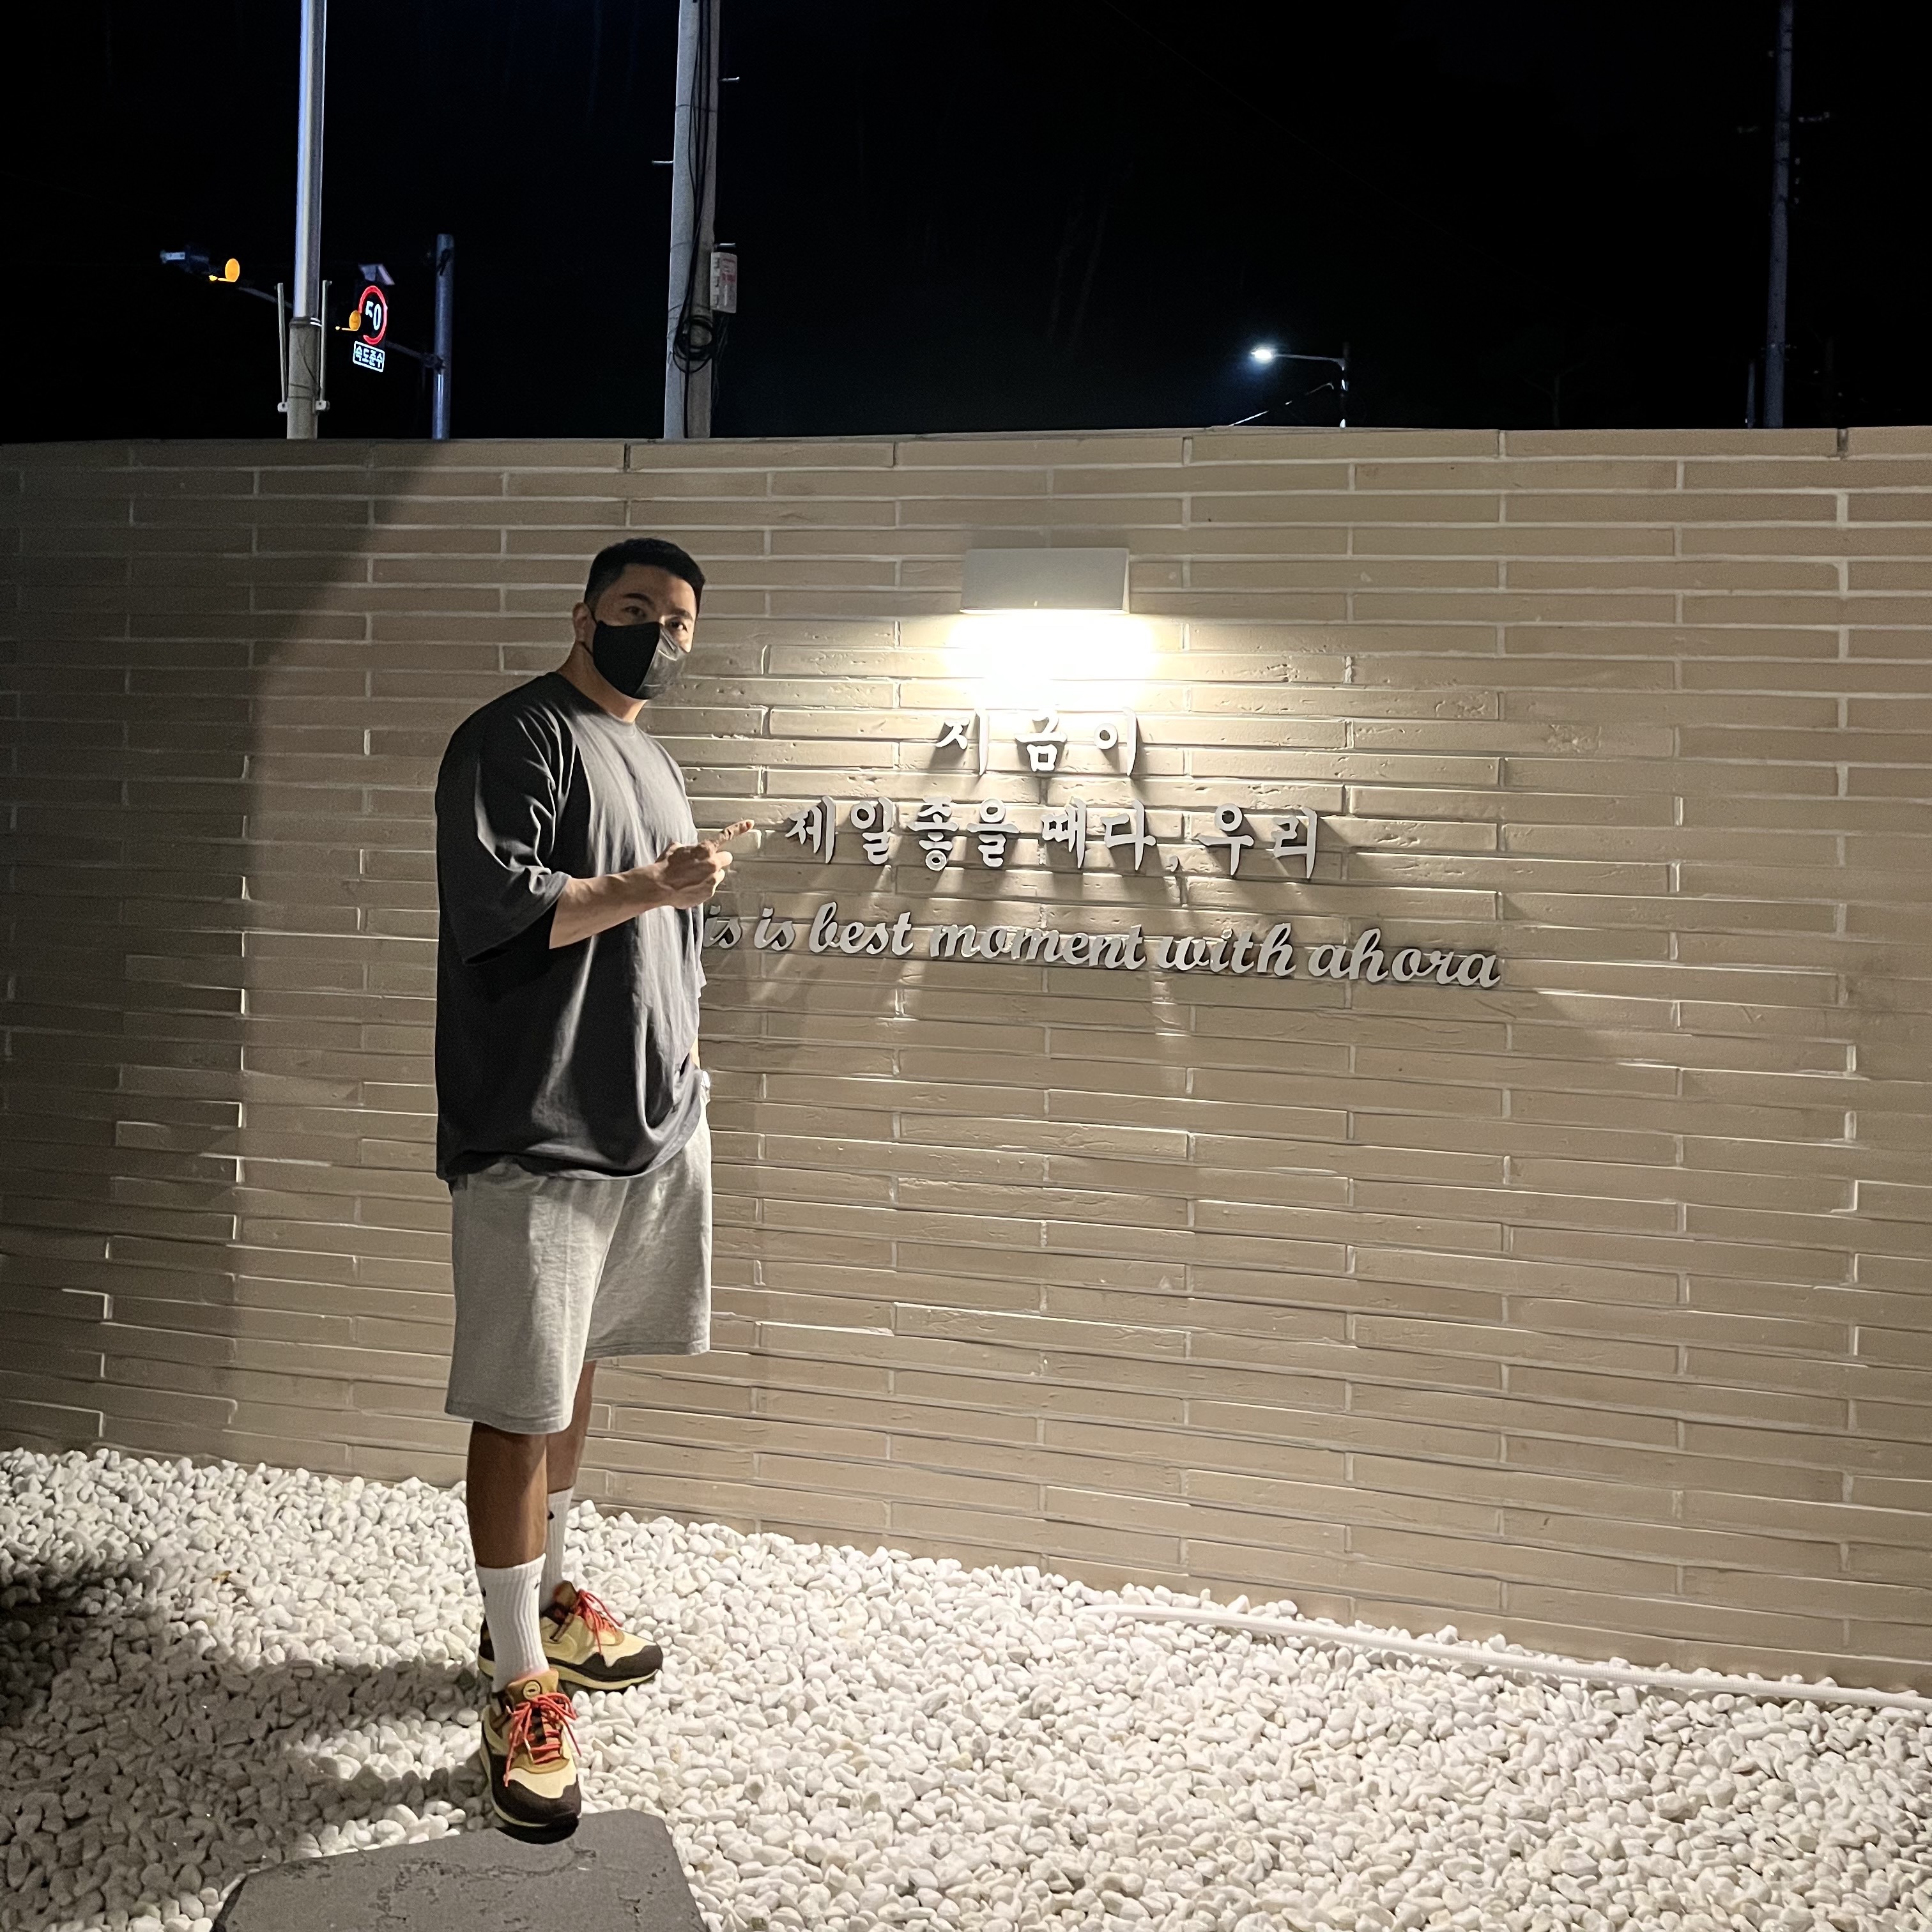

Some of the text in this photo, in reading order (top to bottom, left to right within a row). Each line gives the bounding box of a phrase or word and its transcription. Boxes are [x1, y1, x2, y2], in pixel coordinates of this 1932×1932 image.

[935, 706, 1137, 776] 지금이
[1197, 803, 1317, 878] 우리
[703, 901, 1502, 988] is is best moment with ahora
